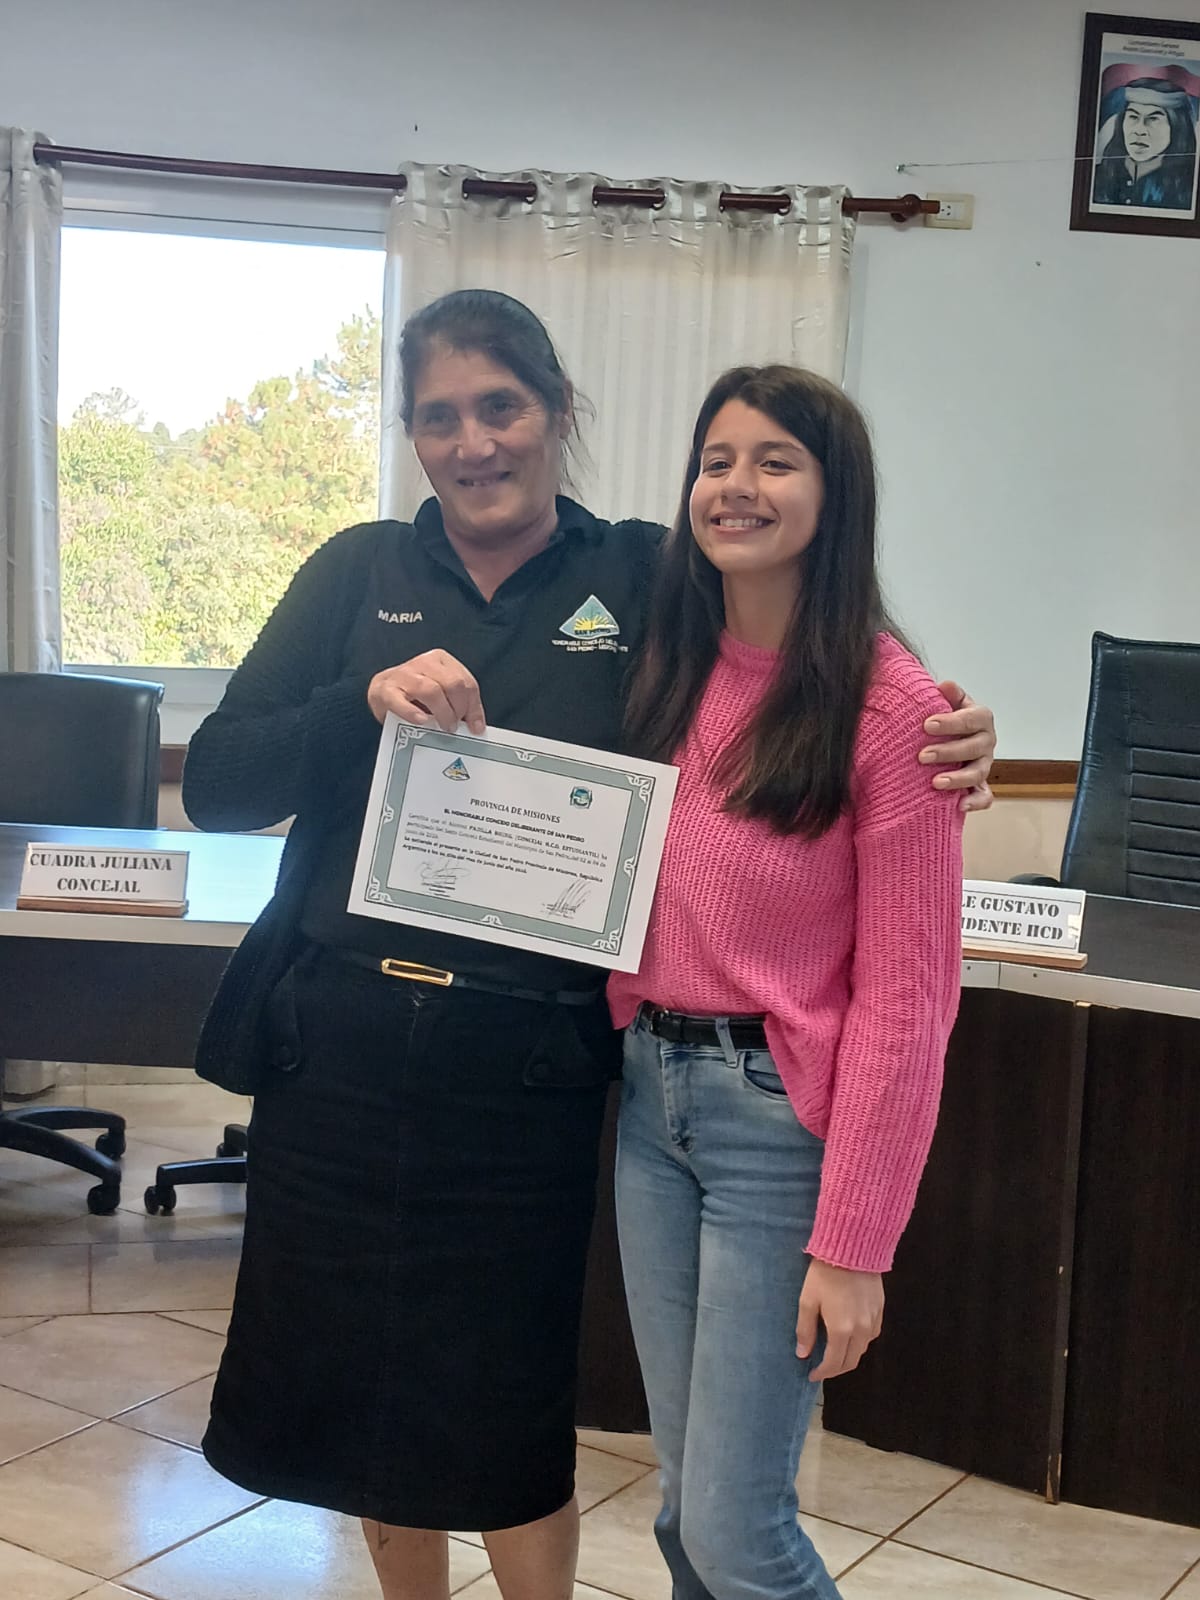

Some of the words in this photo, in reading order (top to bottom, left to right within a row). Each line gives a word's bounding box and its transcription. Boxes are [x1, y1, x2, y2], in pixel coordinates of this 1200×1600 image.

[378, 609, 424, 624] MARIA
[470, 798, 509, 813] PROVINCIA
[510, 806, 522, 814] DE
[522, 808, 560, 823] MISIONES
[566, 834, 584, 842] PEDRO
[30, 853, 96, 868] CUADRA
[100, 856, 172, 870] JULIANA
[56, 878, 141, 893] CONCEJAL
[980, 897, 1060, 918] GUSTAVO
[1027, 924, 1063, 940] HCD
